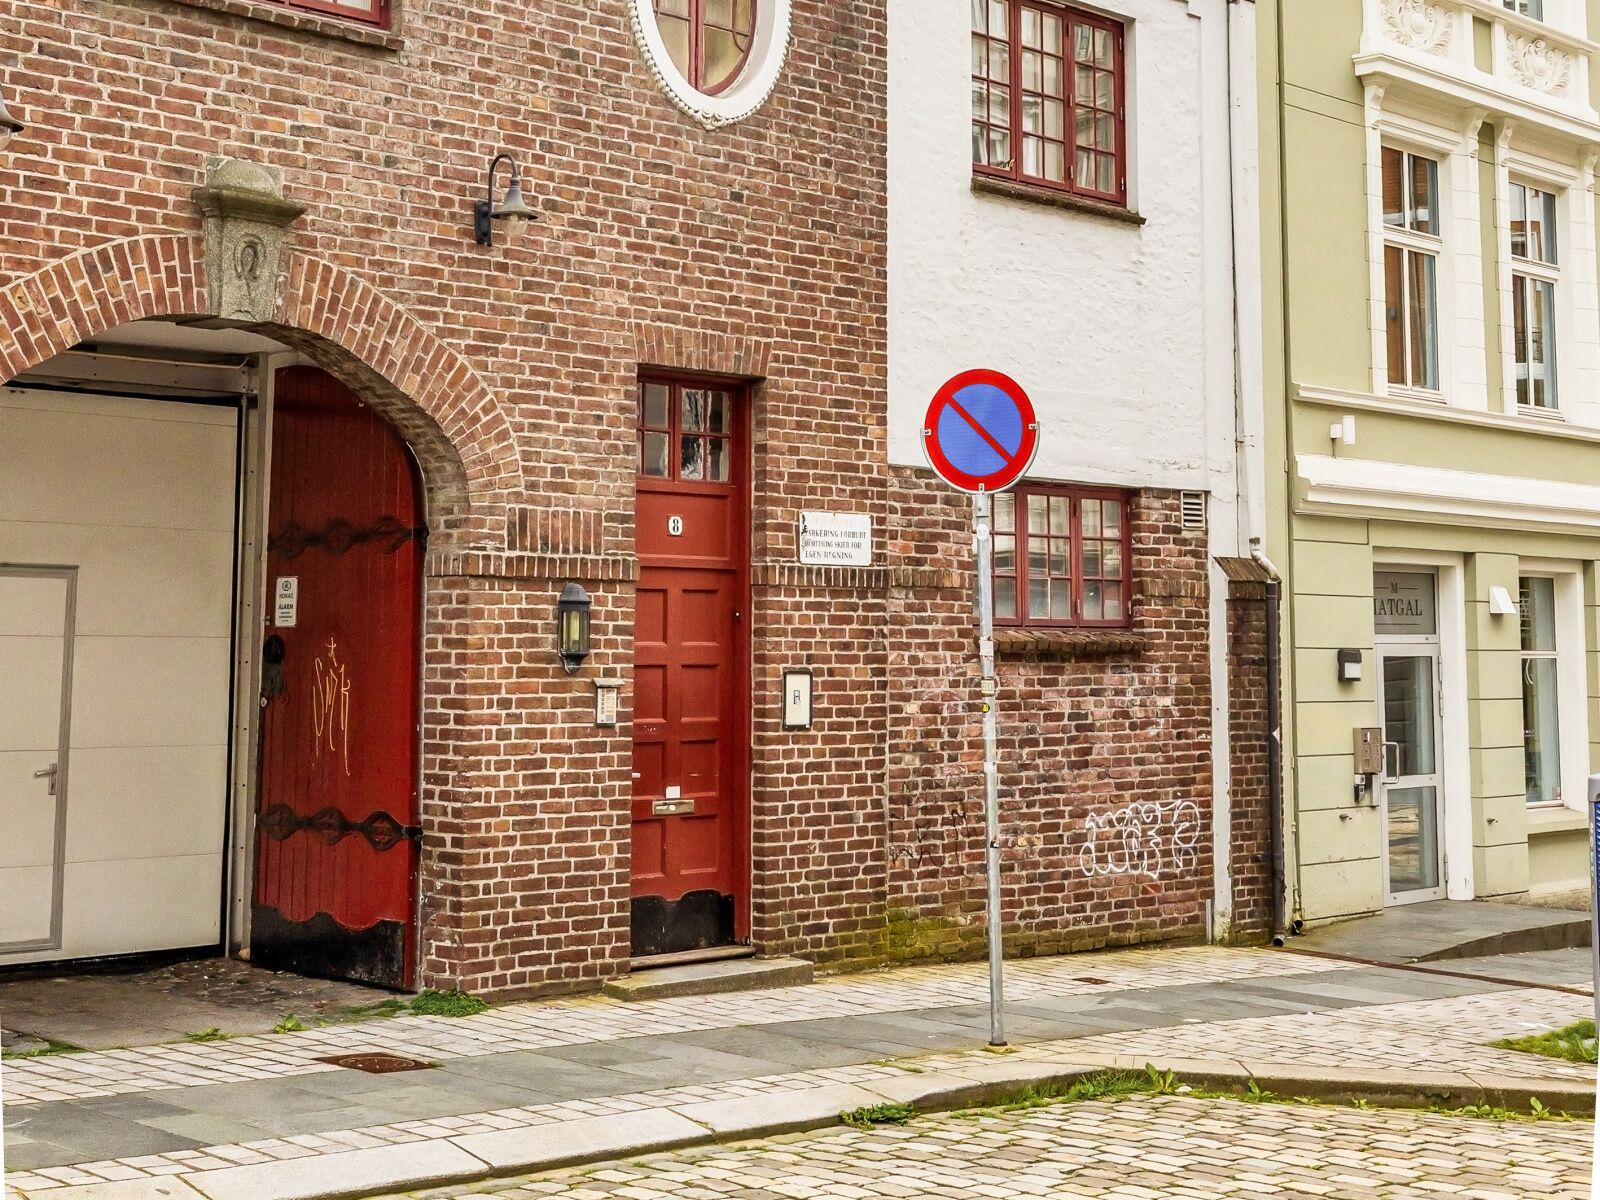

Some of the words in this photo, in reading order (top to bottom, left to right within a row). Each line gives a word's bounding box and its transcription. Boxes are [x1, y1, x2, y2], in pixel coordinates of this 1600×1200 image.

[672, 518, 680, 533] 8
[805, 550, 821, 559] EGEN
[824, 551, 853, 560] REGNING
